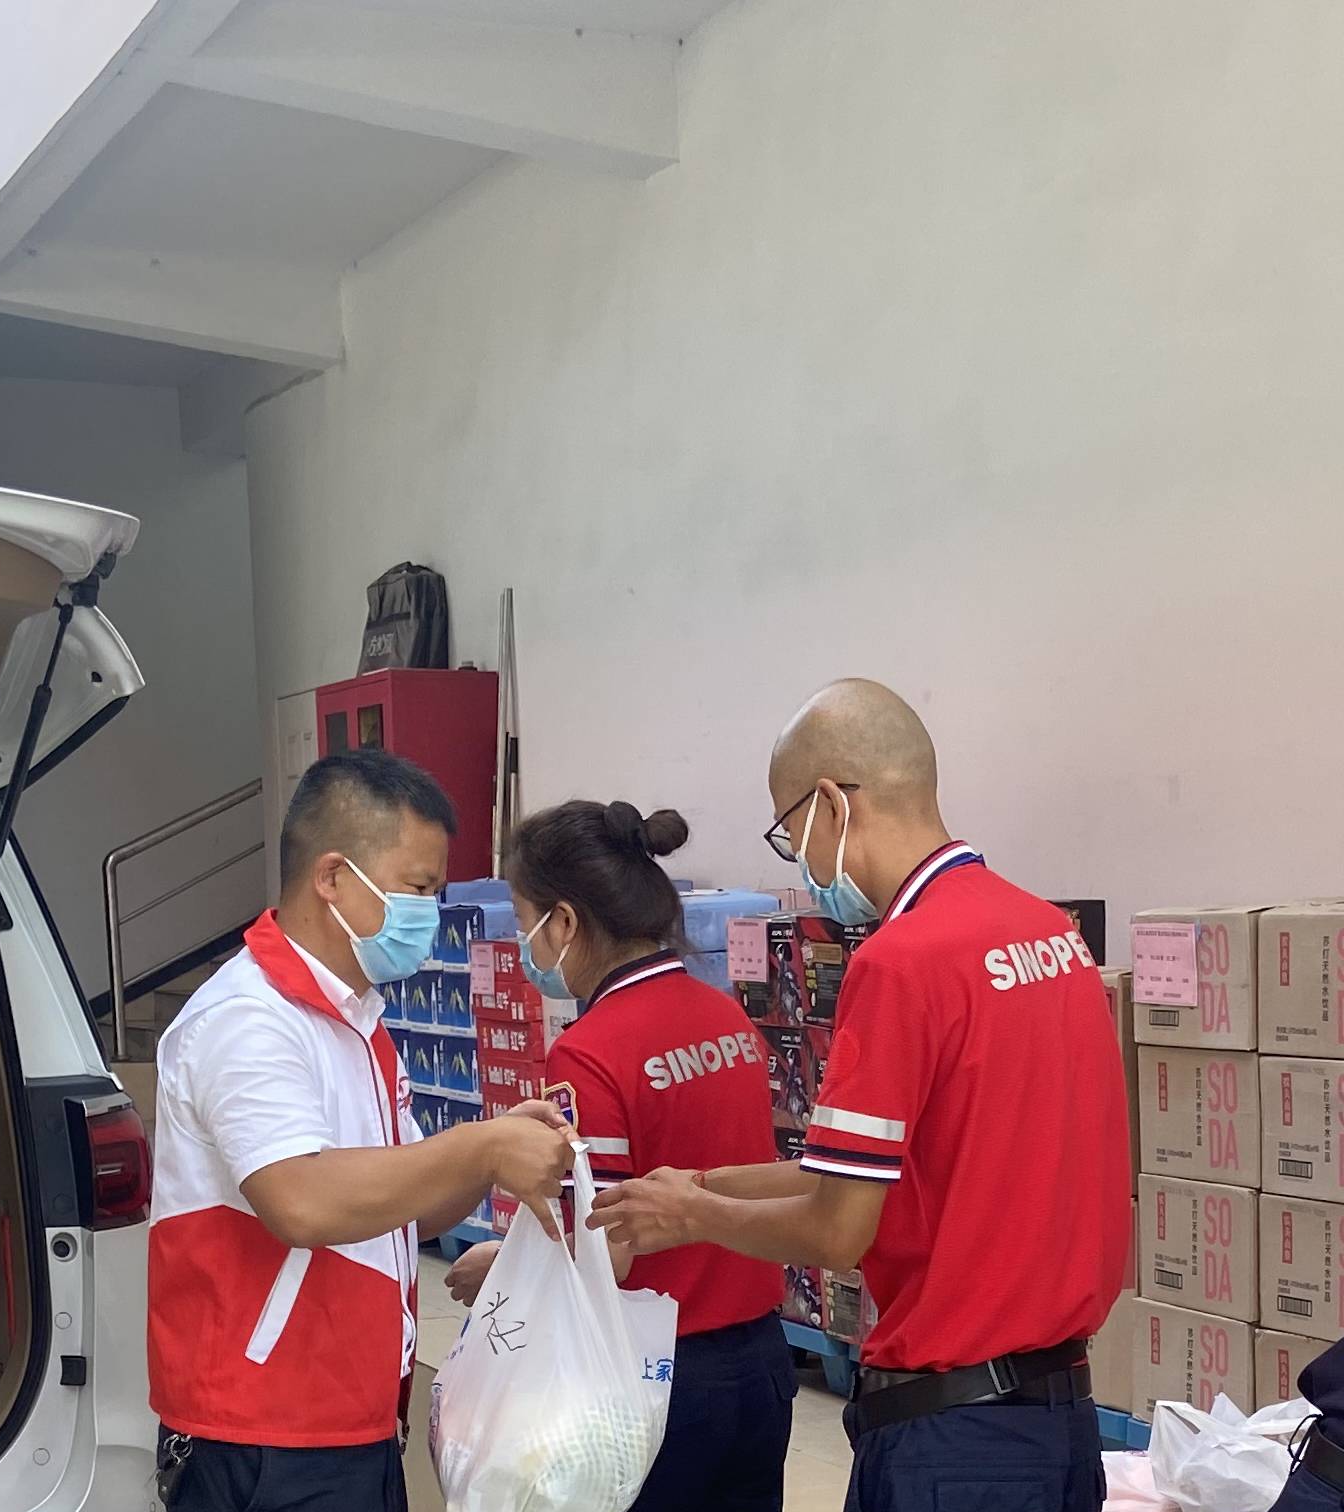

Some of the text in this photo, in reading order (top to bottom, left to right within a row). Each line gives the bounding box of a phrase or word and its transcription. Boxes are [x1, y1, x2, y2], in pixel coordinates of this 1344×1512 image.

[1198, 924, 1229, 976] SO
[1200, 983, 1230, 1033] DA
[1207, 1062, 1238, 1113] SO
[1209, 1118, 1238, 1170] DA
[1203, 1195, 1231, 1248] SO
[1204, 1250, 1232, 1303] DA
[1200, 1325, 1229, 1376] SO
[1200, 1379, 1223, 1413] D
